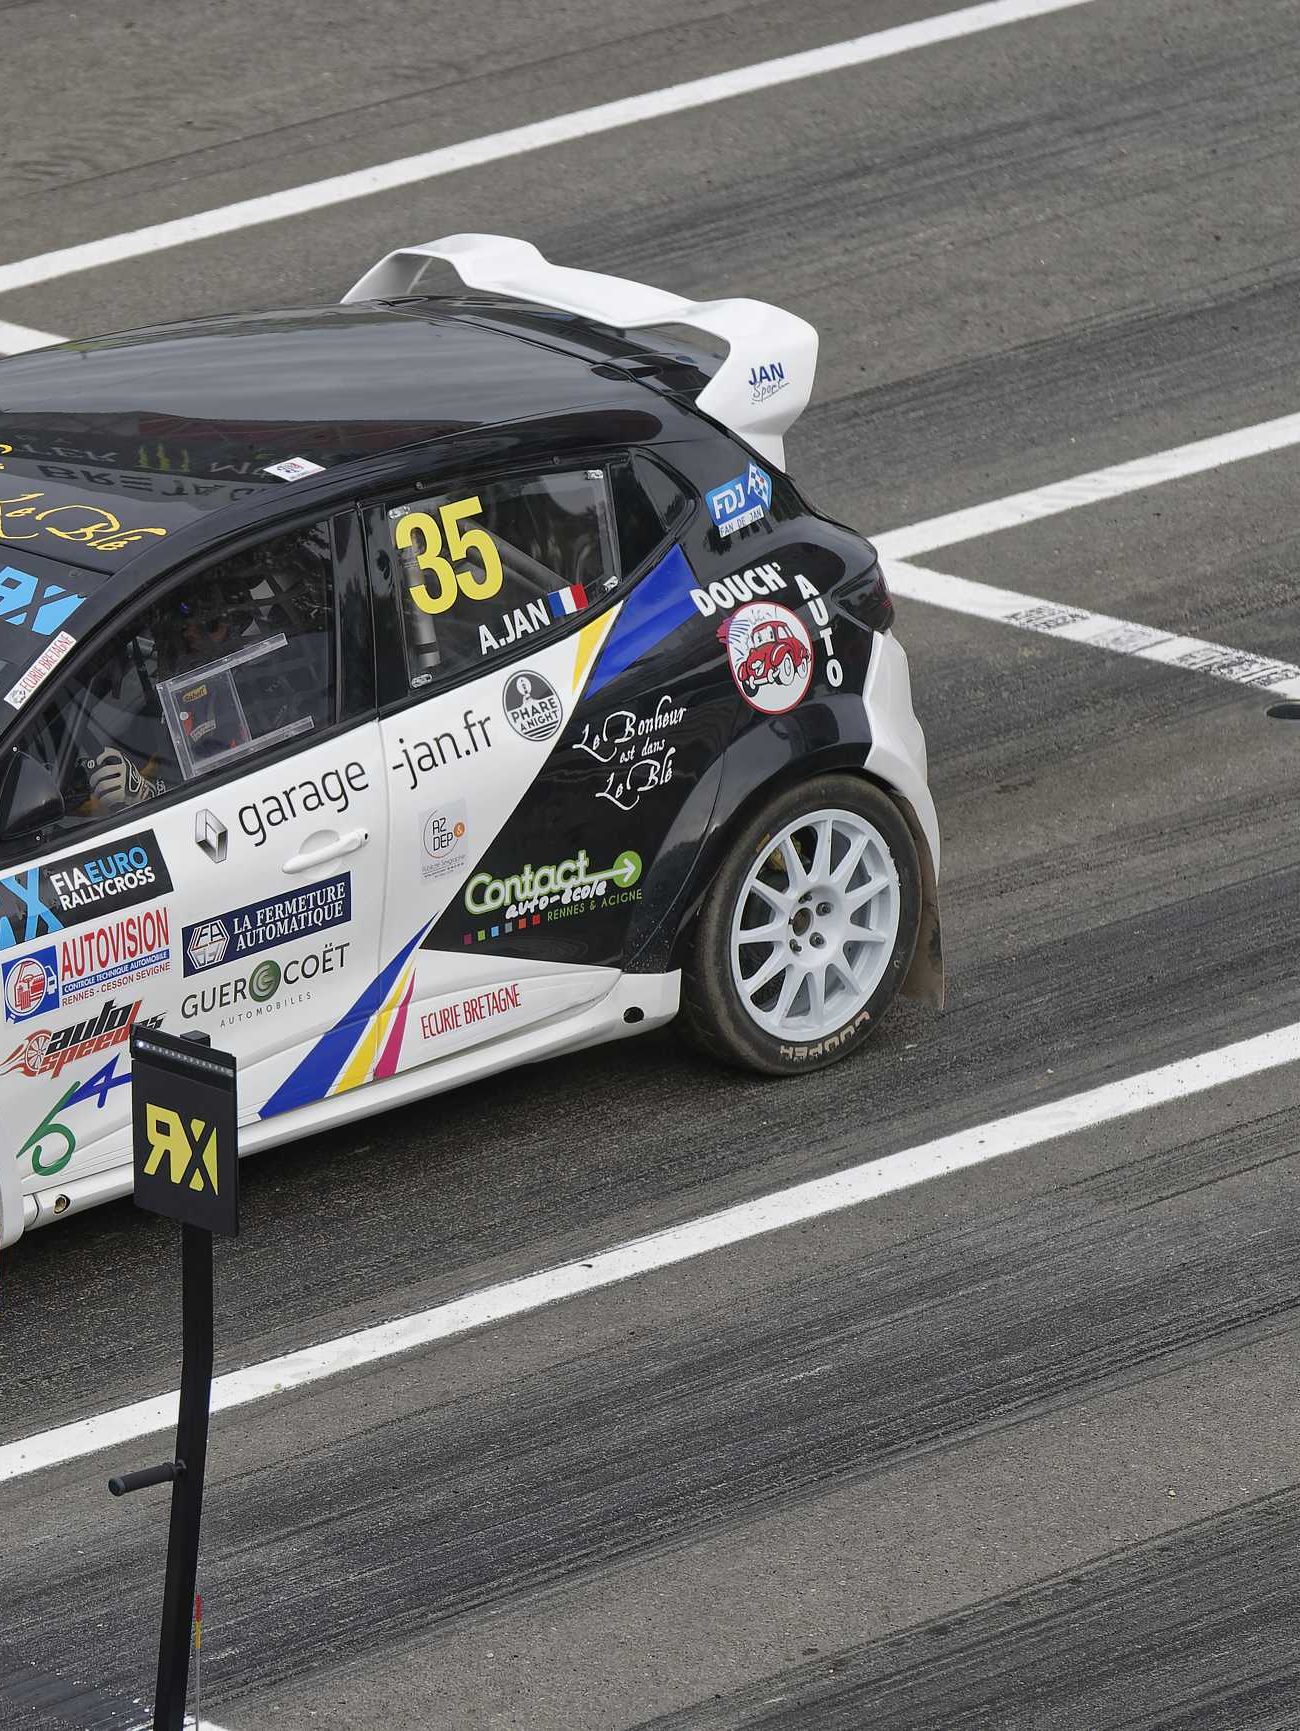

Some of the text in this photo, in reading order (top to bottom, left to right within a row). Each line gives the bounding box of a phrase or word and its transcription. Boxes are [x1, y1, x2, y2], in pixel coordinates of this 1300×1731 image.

[749, 361, 785, 386] JAN
[712, 483, 747, 521] FDJ
[720, 509, 764, 536] FAN DE JAN
[395, 495, 503, 615] 35
[690, 562, 787, 617] DOUCH'
[478, 599, 551, 655] A.JAN
[794, 574, 843, 688] AUTO
[37, 633, 74, 671] BRETAGNE
[510, 696, 558, 724] PHARE
[603, 695, 687, 743] Bonheur
[641, 737, 665, 757] dans
[238, 761, 369, 847] garage
[432, 817, 447, 835] AZ
[433, 832, 454, 851] DEP
[59, 867, 155, 911] RALLYCROSS
[465, 850, 590, 915] Contact
[547, 889, 643, 921] RENNES & ACIGNE
[233, 882, 346, 934] LA FERMETURE
[236, 901, 343, 951] AUTOMATIQUE
[61, 907, 170, 982] AUTOVISION
[95, 966, 129, 984] TECHNIQUE
[130, 951, 168, 972] AUTOMOBILE
[62, 990, 95, 1006] RENNES
[101, 975, 134, 993] CESSON
[136, 962, 171, 982] SEVIGNE
[45, 999, 133, 1056] auto
[220, 992, 312, 1028] AUTOMOBILES
[420, 983, 522, 1039] ECURIE BRETAGNE
[143, 1102, 218, 1196] RX
